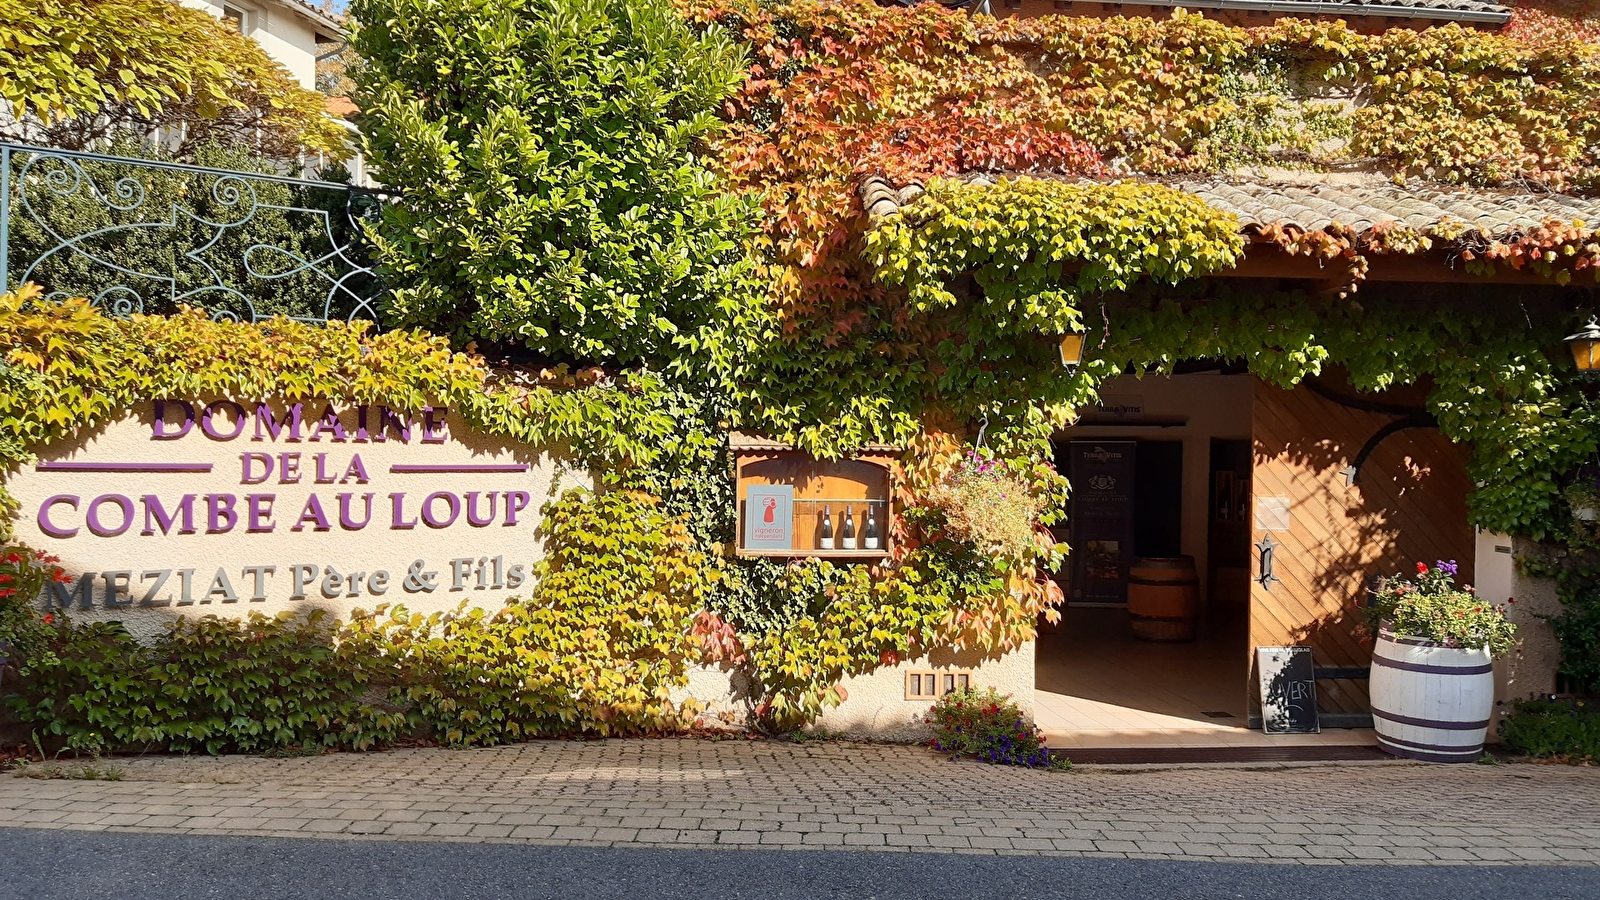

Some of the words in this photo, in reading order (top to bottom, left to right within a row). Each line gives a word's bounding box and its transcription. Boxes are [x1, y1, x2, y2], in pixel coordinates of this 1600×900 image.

[151, 400, 448, 443] DOMAINE
[239, 451, 302, 485] DE
[313, 452, 371, 485] LA
[37, 493, 277, 539] COMBE
[290, 492, 375, 532] AU
[388, 490, 530, 530] LOUP
[45, 565, 277, 609] MEZIAT
[289, 563, 390, 600] Père
[402, 559, 439, 593] &
[449, 555, 526, 592] Fils
